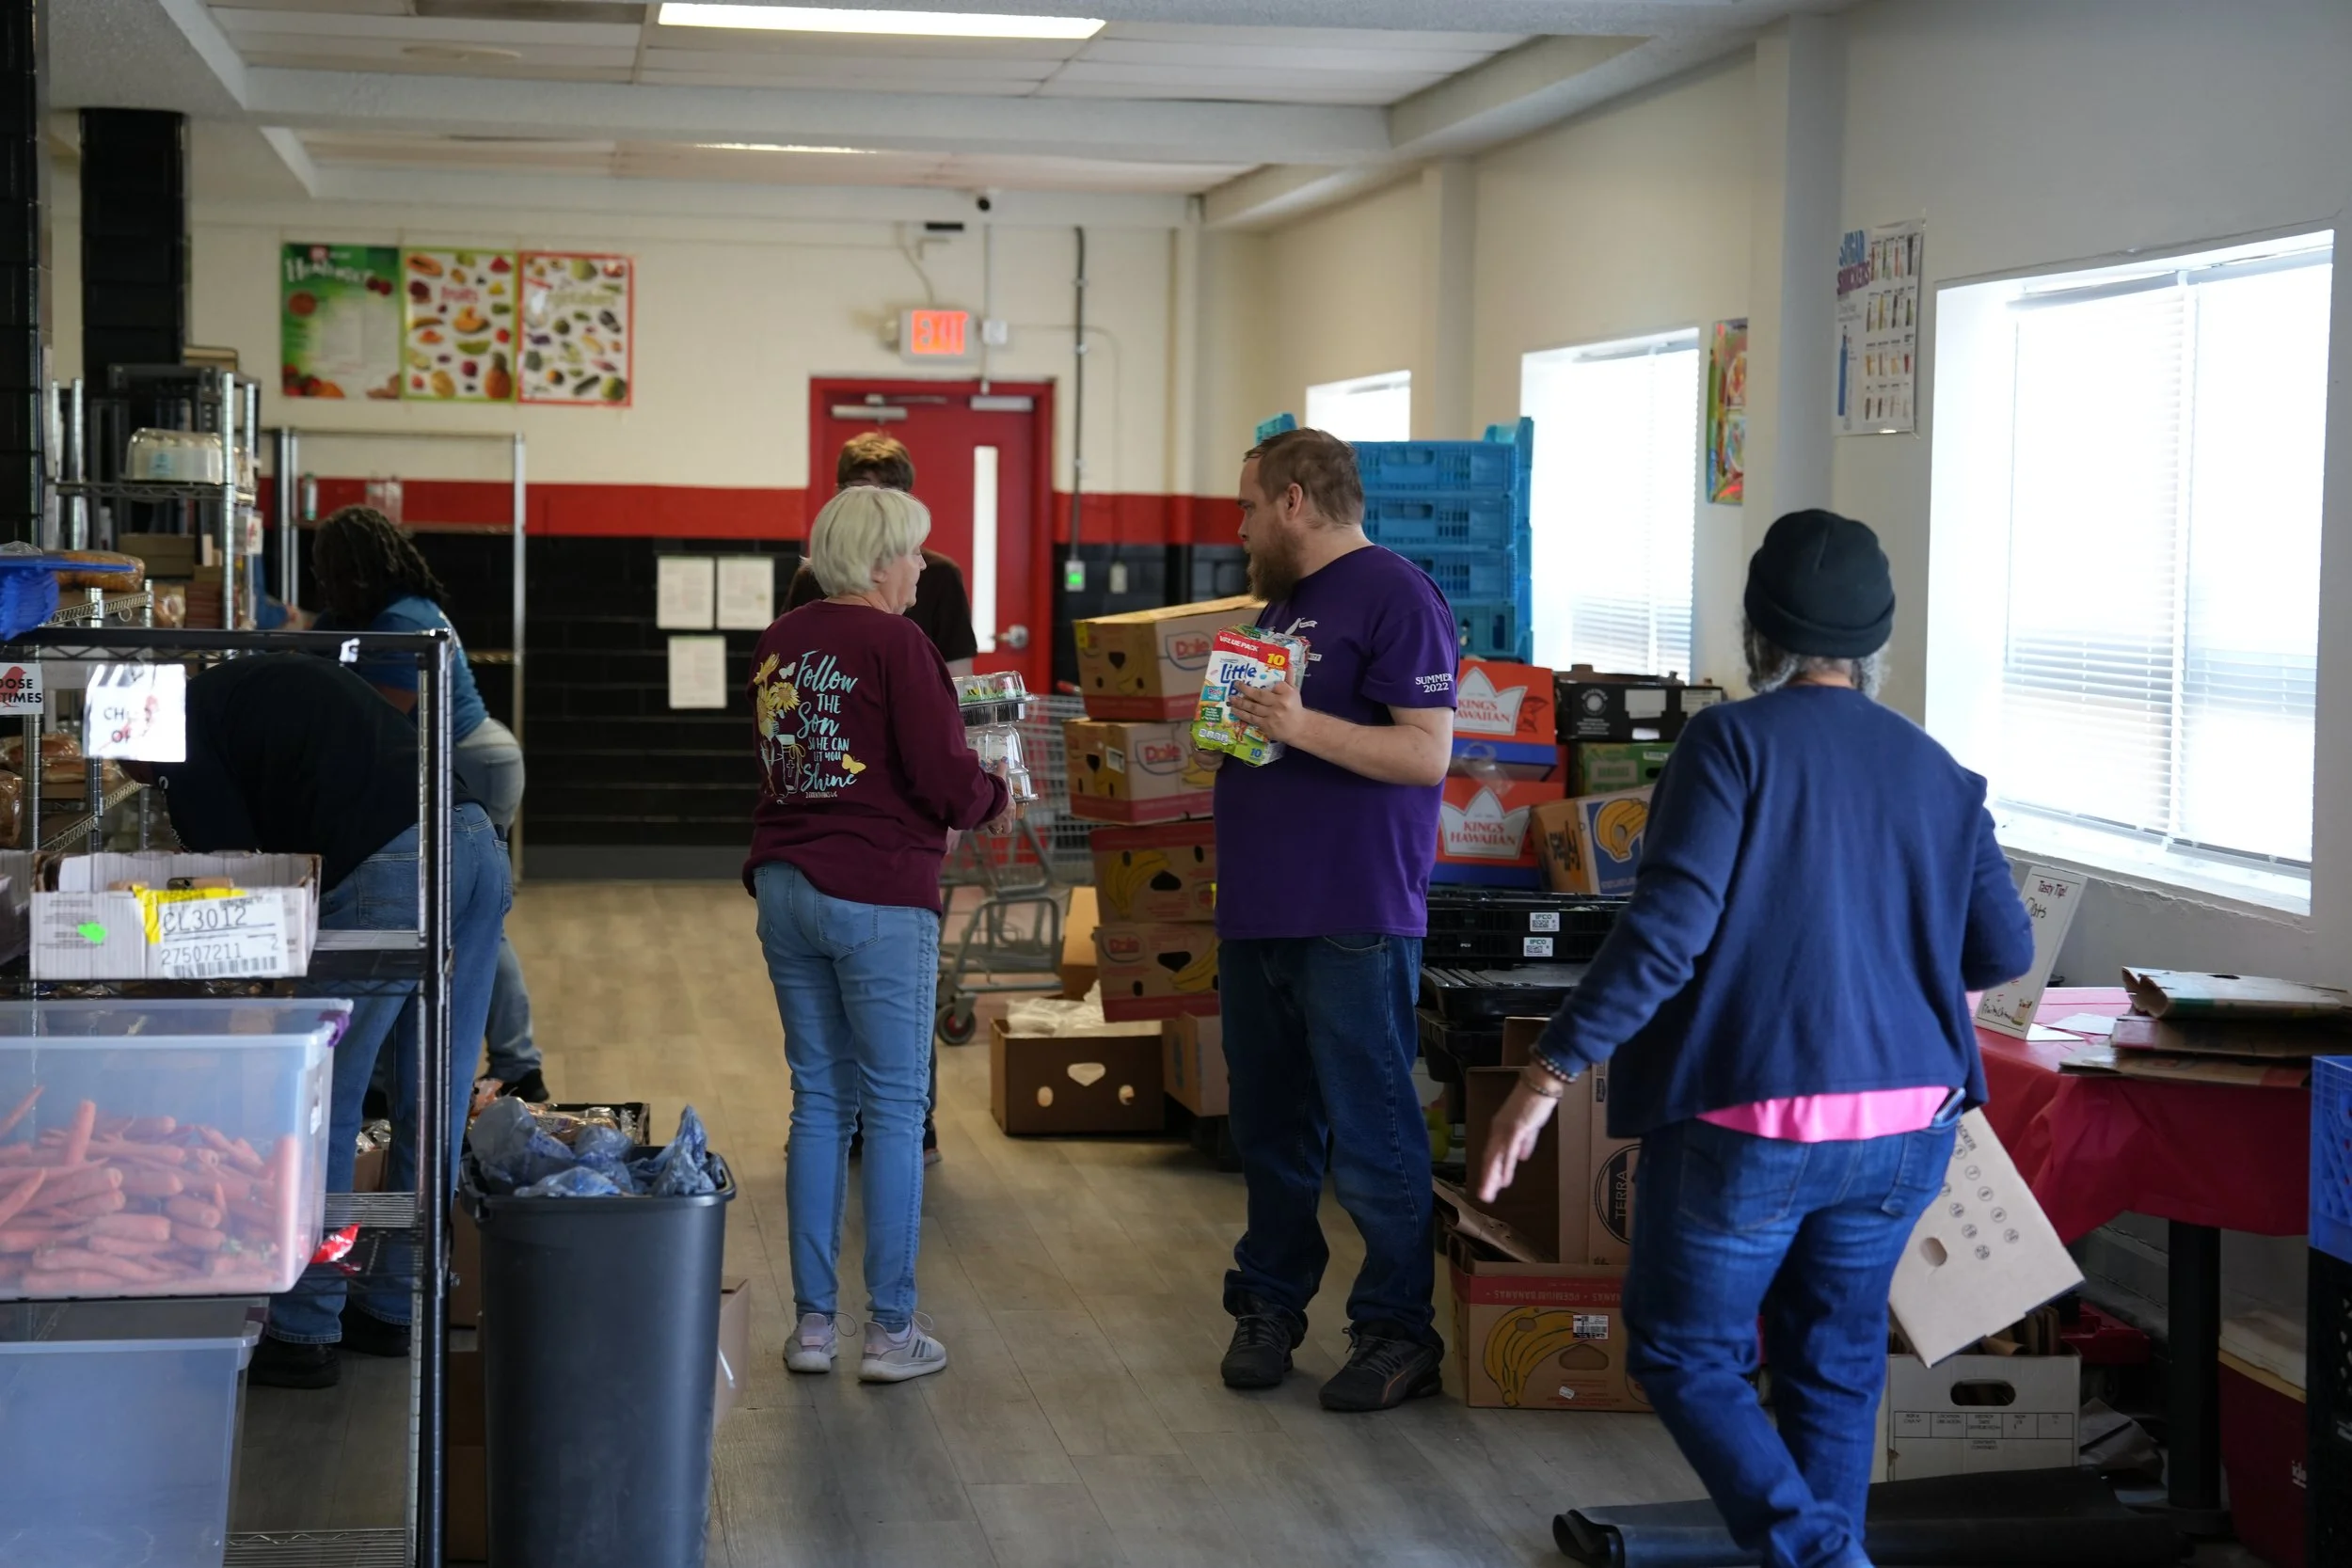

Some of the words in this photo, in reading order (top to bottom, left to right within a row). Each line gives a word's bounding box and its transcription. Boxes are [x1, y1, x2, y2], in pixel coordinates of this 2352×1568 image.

[911, 309, 969, 355] EXIT
[1175, 638, 1210, 657] Dole
[1219, 634, 1244, 648] VALUE
[1240, 641, 1261, 652] PACK
[1266, 652, 1286, 666] 10
[795, 648, 858, 693] Follow
[1219, 662, 1258, 684] Little
[1415, 673, 1454, 686] SUMMER
[1423, 682, 1450, 694] 2022
[0, 692, 42, 704] TIMES
[817, 693, 841, 714] THE
[797, 701, 840, 738] Son
[1456, 710, 1510, 723] AWAIIAN
[817, 736, 829, 751] HE
[832, 737, 850, 752] CAN
[1144, 743, 1182, 762] Dole
[825, 752, 841, 762] YOU
[801, 762, 858, 792] Shine
[1450, 831, 1517, 846] HAWAIIAN
[163, 906, 247, 933] CL3012
[161, 942, 242, 966] 27507211
[1614, 1169, 1628, 1220] TERRA
